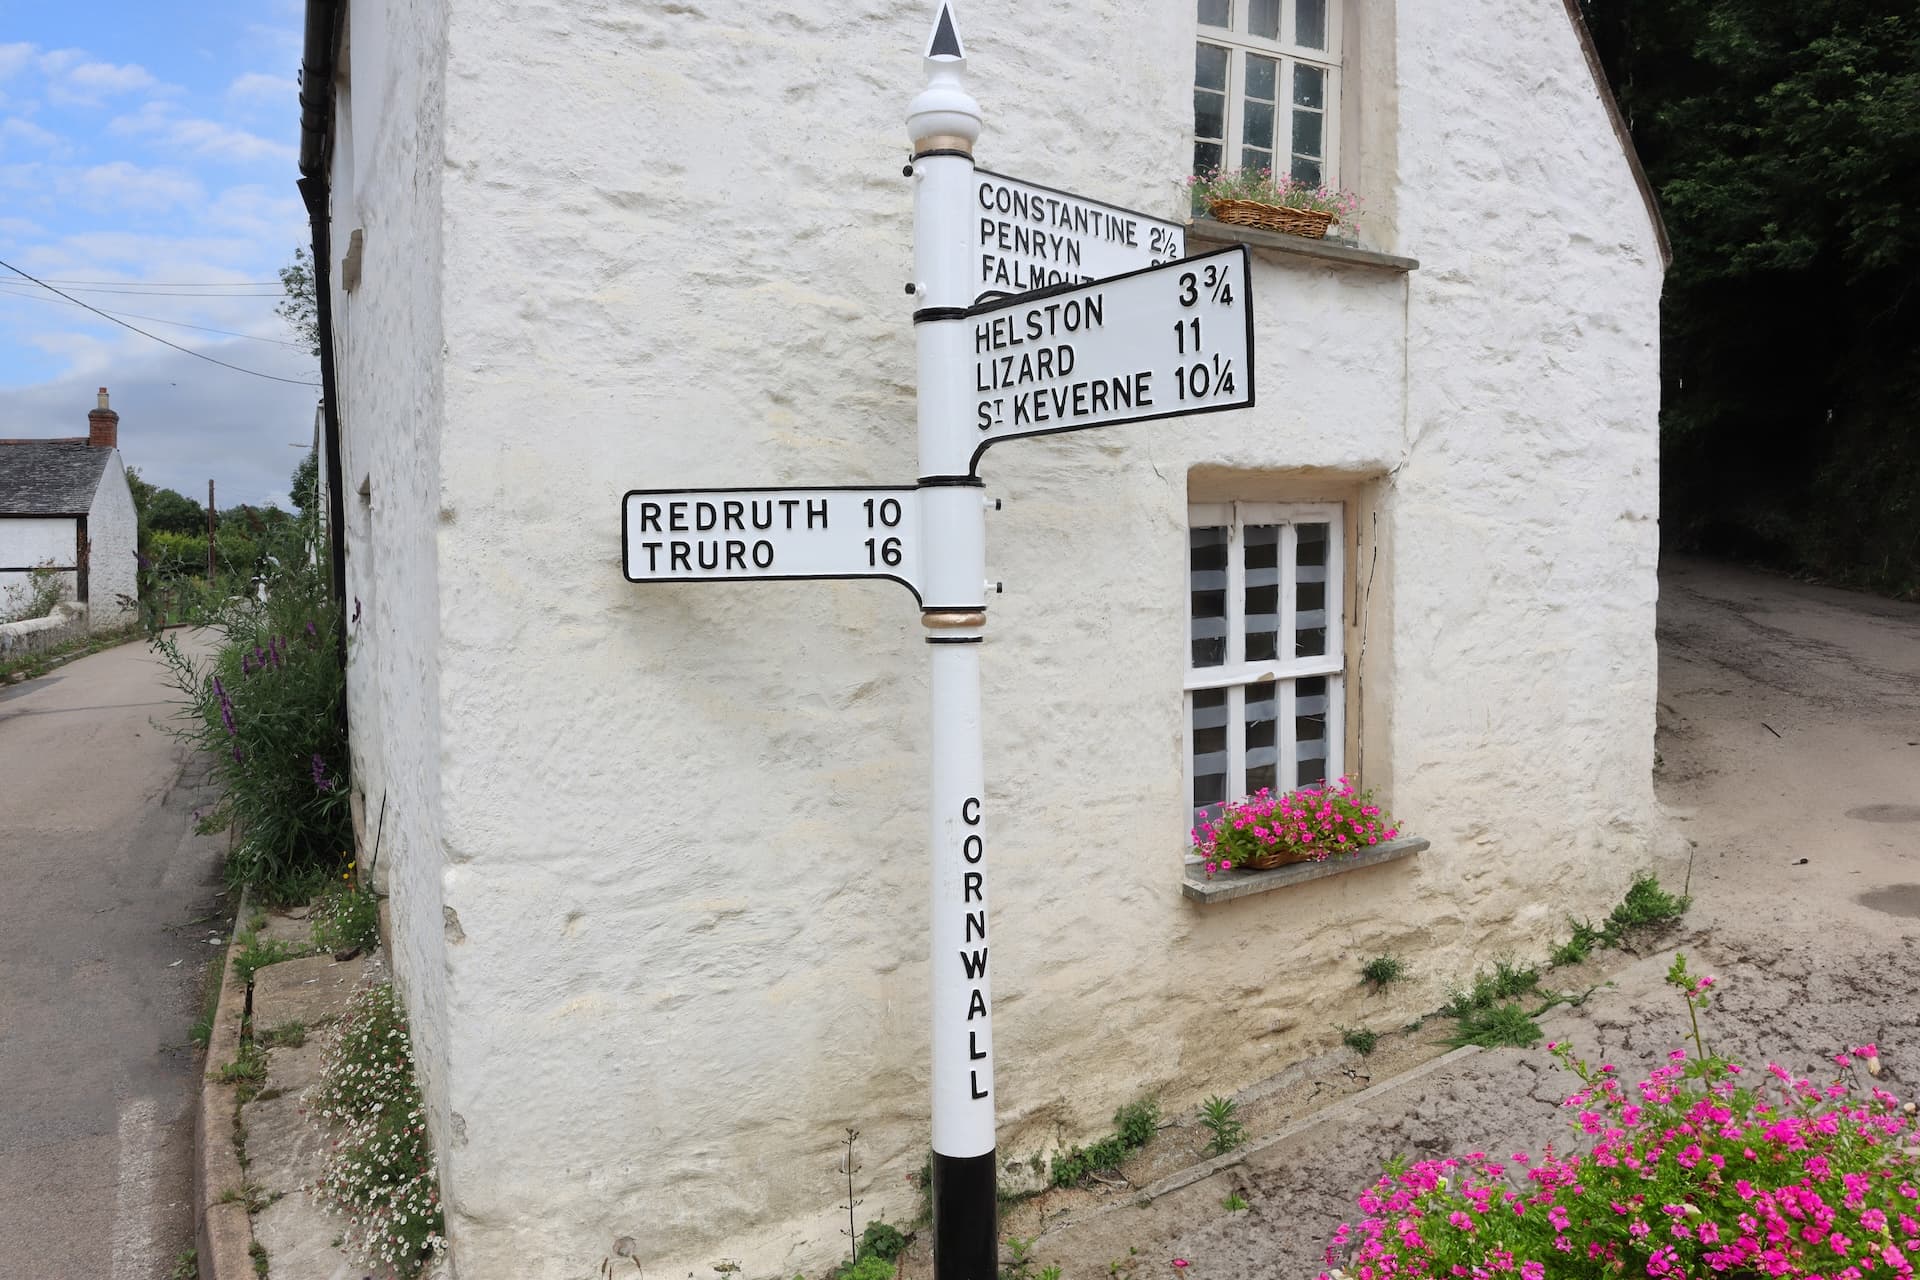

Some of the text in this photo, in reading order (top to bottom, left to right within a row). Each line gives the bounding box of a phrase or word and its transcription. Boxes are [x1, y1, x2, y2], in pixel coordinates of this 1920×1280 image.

[979, 182, 1138, 248] CONSTANTINE
[981, 218, 1081, 266] PENRYN
[975, 294, 1103, 354] HELSTON
[977, 317, 1200, 392] LIZARD 11
[1014, 371, 1153, 426] KEVERNE
[641, 498, 902, 532] REDRUTH 10
[642, 537, 902, 571] TRURO 16
[960, 797, 989, 1100] CORNWALL
